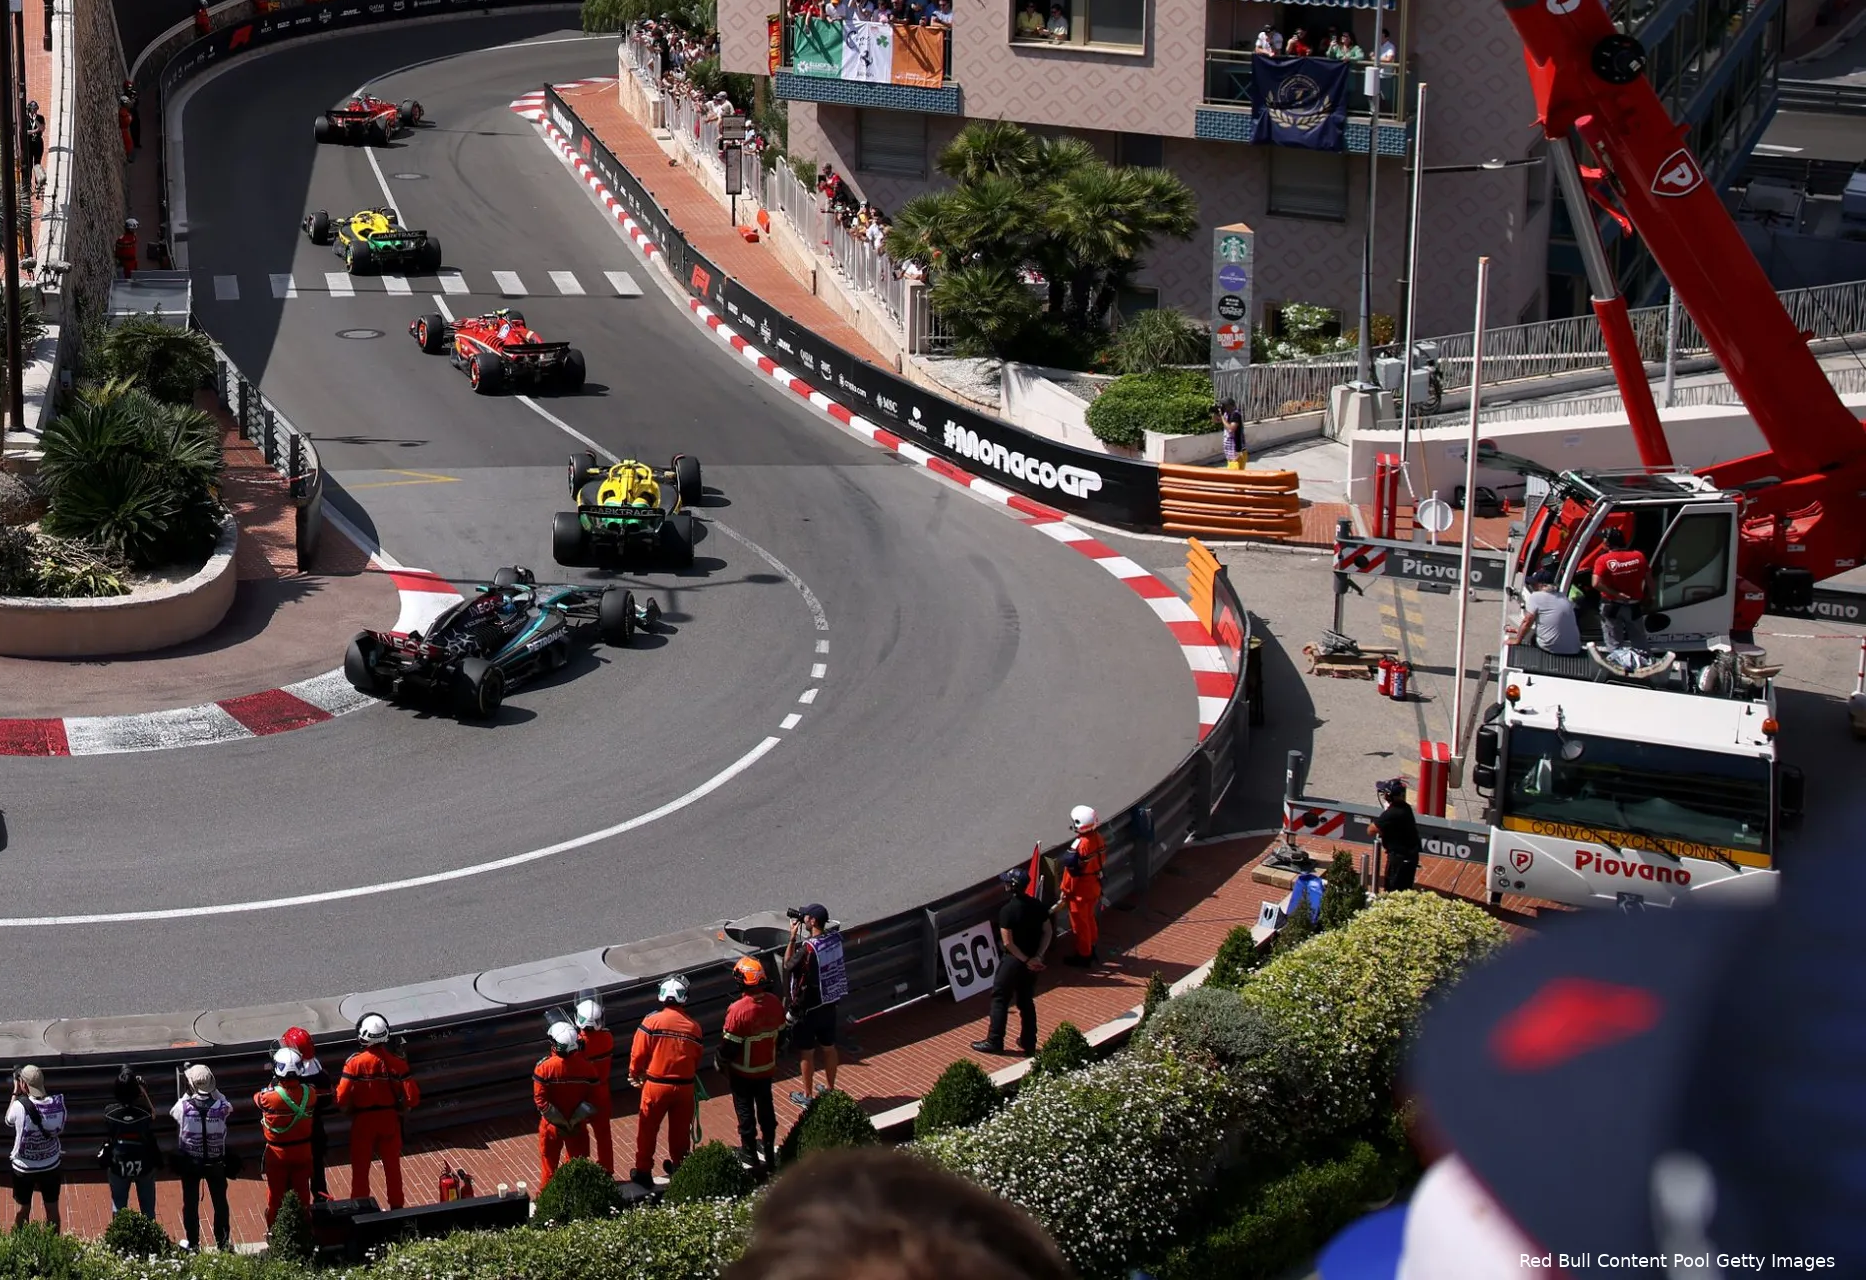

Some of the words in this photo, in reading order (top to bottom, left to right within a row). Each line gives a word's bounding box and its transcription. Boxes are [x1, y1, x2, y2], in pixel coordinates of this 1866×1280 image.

[1216, 333, 1246, 342] BOWLING
[883, 397, 898, 413] MSC
[943, 420, 1102, 499] #MonacoGP
[1402, 558, 1482, 582] Piovao
[469, 599, 495, 617] INEOS
[375, 632, 429, 656] INEOS
[1575, 849, 1691, 886] Piovano
[949, 934, 995, 988] SC
[118, 1160, 143, 1177] 127
